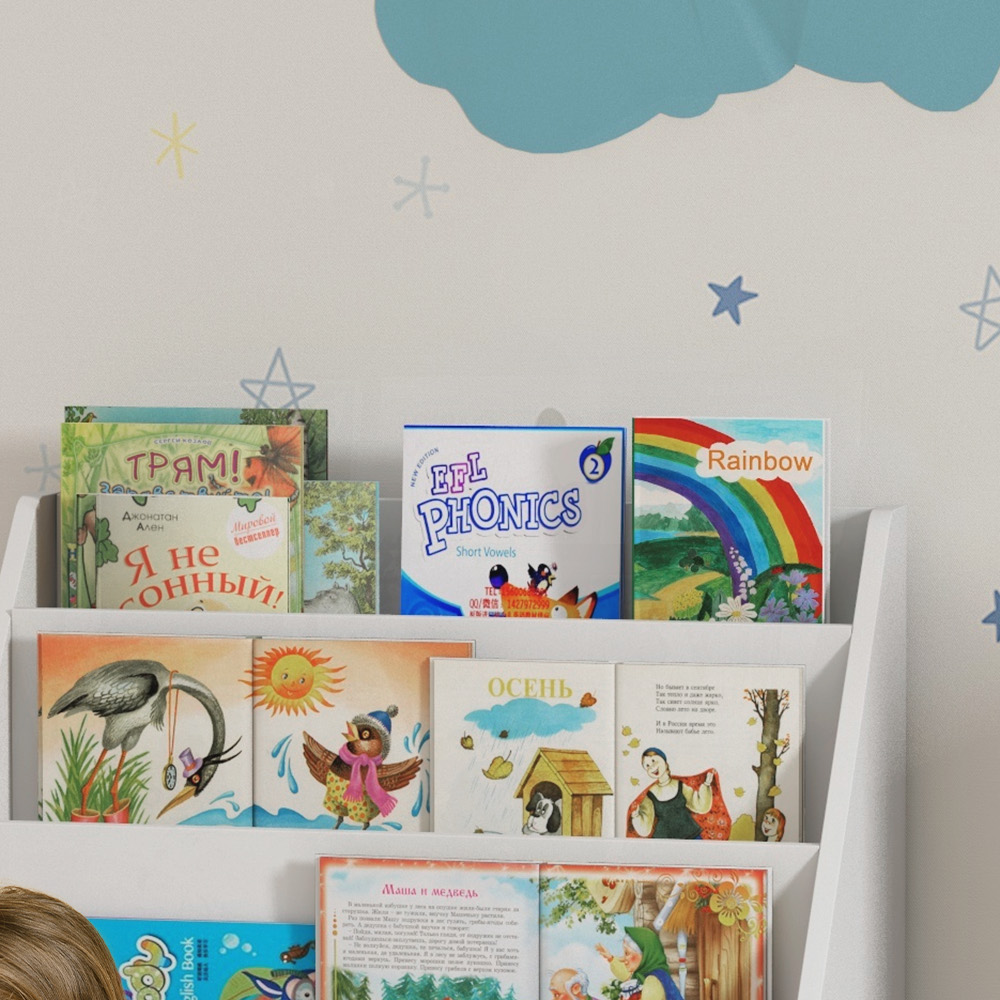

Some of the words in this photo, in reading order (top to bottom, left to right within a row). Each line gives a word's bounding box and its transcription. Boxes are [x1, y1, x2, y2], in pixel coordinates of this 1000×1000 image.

[126, 450, 239, 483] ТРЯМ!
[410, 469, 419, 488] NEW
[416, 447, 439, 469] EDITION
[589, 457, 600, 475] 2
[708, 450, 813, 471] Rainbow
[431, 451, 488, 495] EFL
[122, 511, 179, 521] Джонатан
[231, 513, 276, 533] Мировой
[417, 487, 582, 556] PHONICS
[136, 522, 164, 532] Ален
[456, 546, 481, 558] Short
[484, 546, 517, 558] Vowels
[124, 544, 157, 586] Я
[168, 545, 220, 571] не
[488, 677, 573, 698] ОСЕНЬ
[382, 884, 417, 896] Маша
[421, 888, 428, 896] и
[431, 888, 478, 899] медведь
[180, 937, 194, 970] Book
